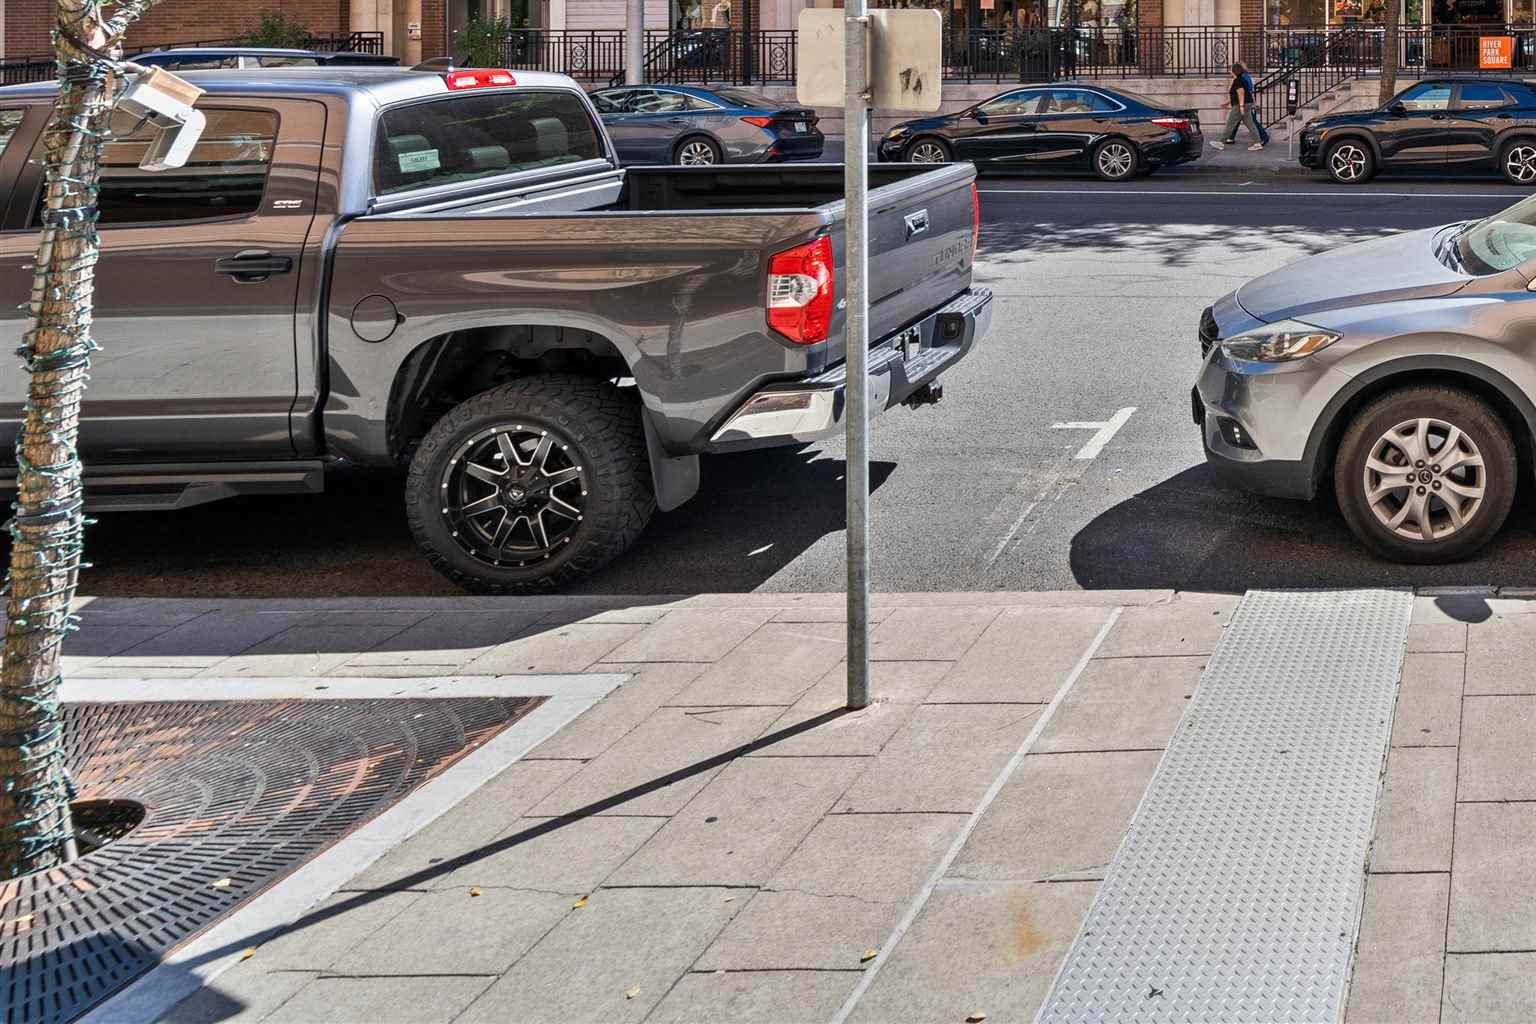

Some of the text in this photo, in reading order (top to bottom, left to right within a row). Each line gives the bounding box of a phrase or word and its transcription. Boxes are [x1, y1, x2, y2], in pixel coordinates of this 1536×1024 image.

[1482, 39, 1502, 48] RIVER
[1482, 48, 1500, 56] PARK
[1482, 56, 1508, 64] SQUARE
